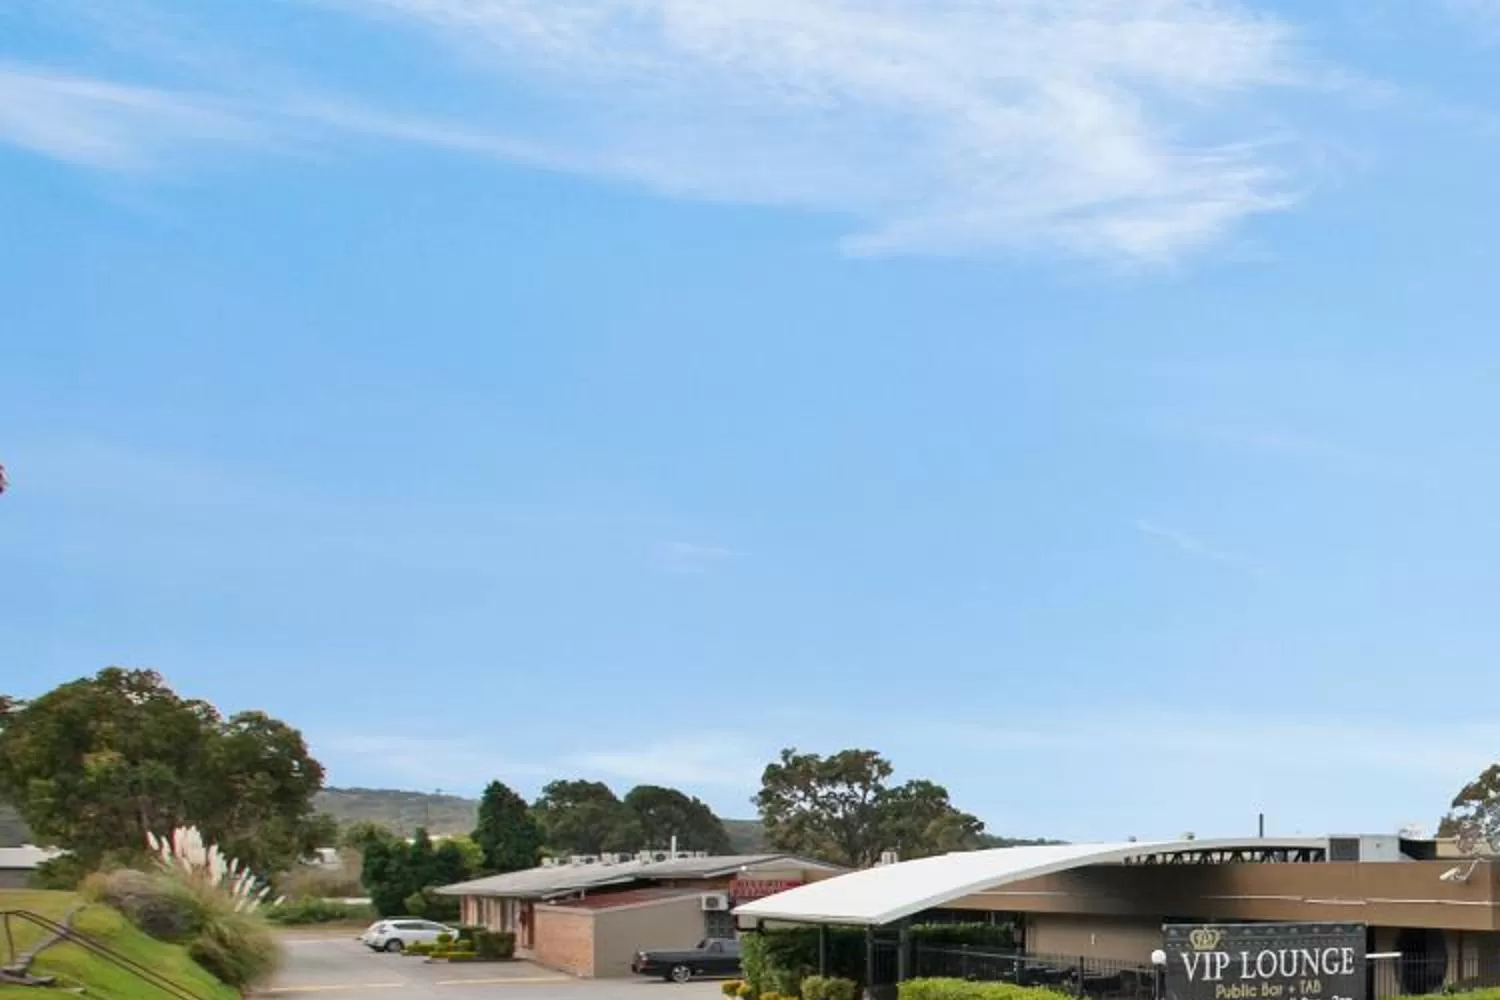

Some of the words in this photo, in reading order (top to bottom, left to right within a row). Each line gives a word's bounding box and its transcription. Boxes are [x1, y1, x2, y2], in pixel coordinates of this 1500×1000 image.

[1181, 951, 1230, 982] VIP
[1240, 947, 1355, 980] LOUNGE
[1215, 982, 1258, 1000] Public
[1261, 982, 1284, 997] Bar
[1300, 979, 1321, 995] TAB
